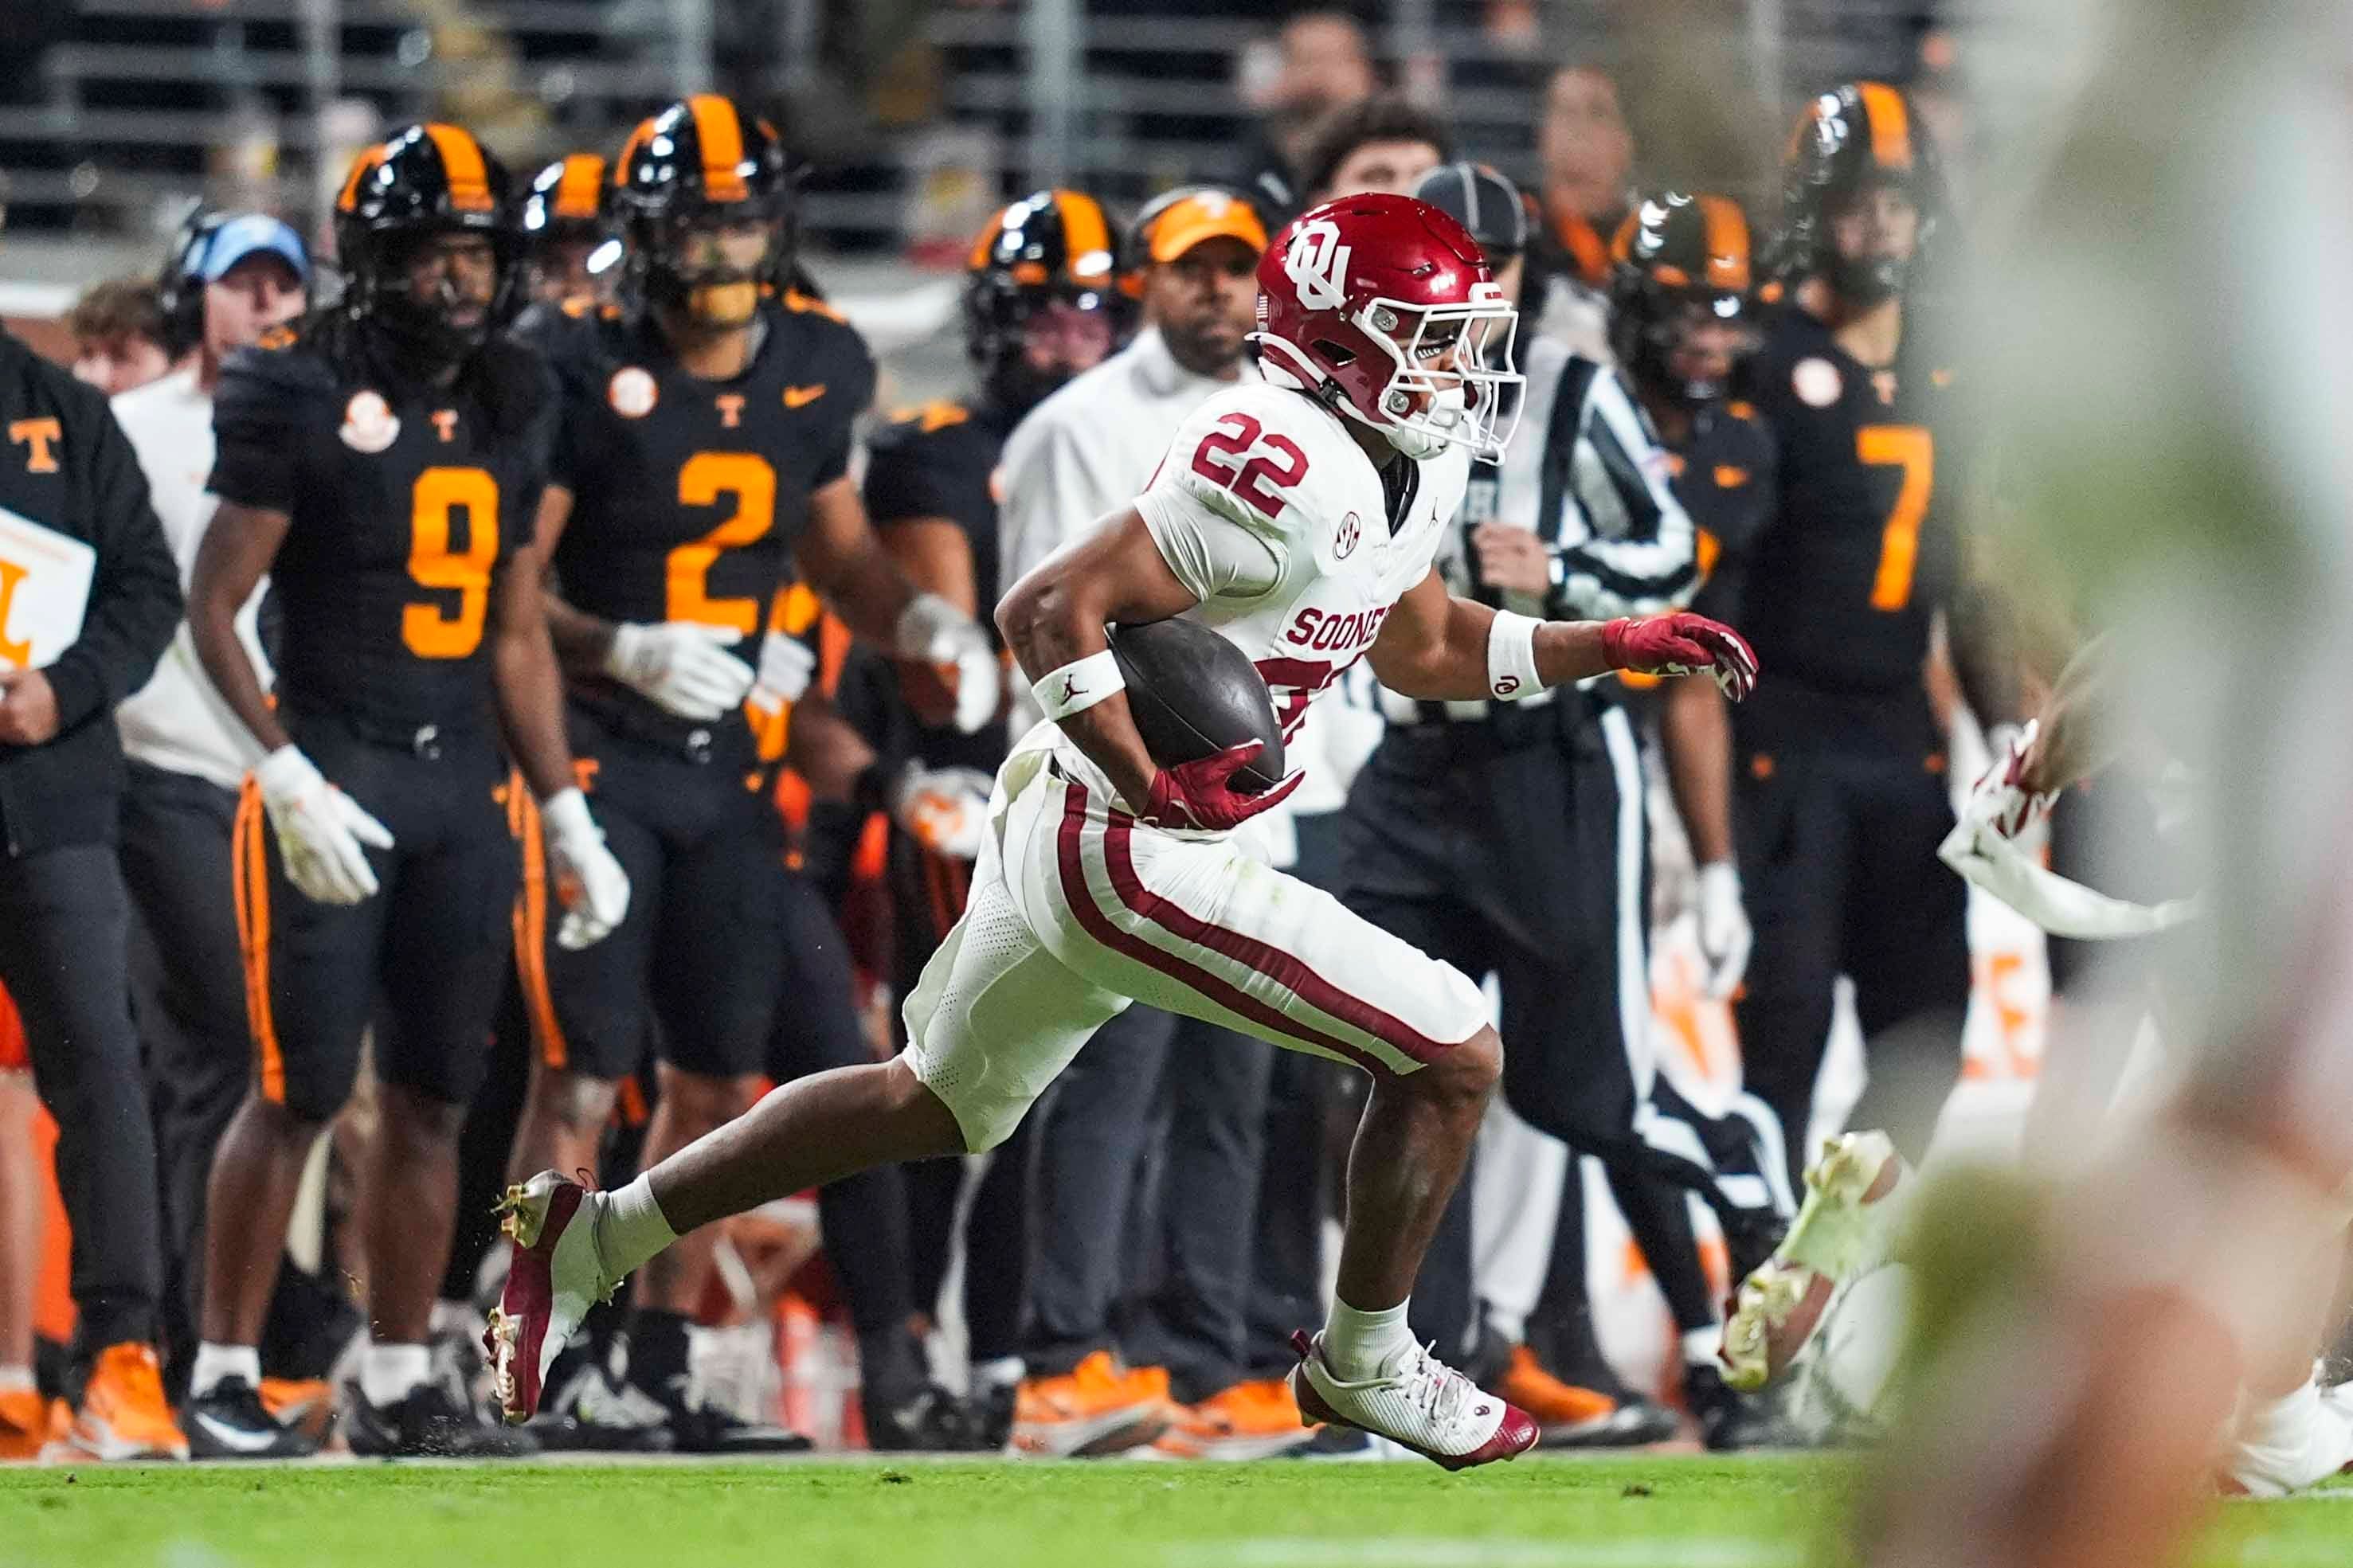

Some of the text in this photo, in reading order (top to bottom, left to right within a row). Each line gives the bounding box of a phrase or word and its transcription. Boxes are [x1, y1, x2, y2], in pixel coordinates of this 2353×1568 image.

[1284, 219, 1352, 311] OU
[8, 415, 62, 473] T
[716, 393, 746, 428] T
[1192, 412, 1310, 519] 22
[402, 467, 499, 659] 9
[666, 450, 777, 635] 2
[1855, 424, 1934, 610] 7
[1286, 604, 1394, 651] SOONE
